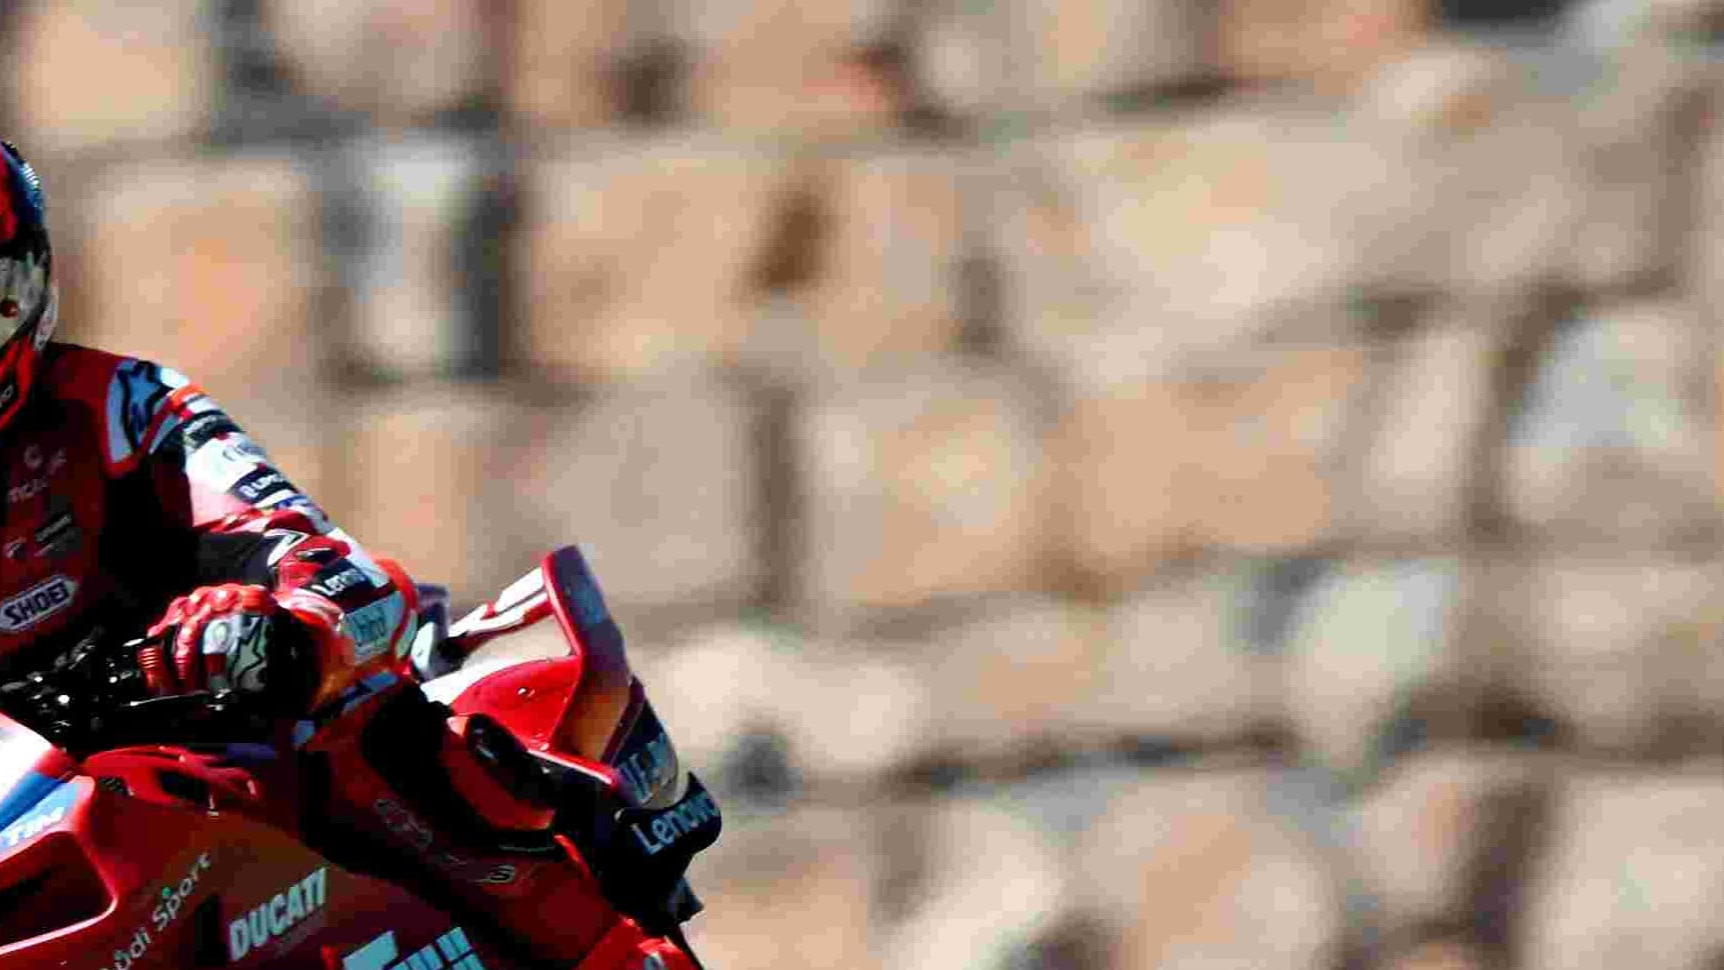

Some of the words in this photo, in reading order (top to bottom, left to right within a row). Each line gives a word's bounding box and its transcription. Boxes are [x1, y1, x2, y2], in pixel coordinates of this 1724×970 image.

[4, 580, 71, 627] SHOEI
[151, 851, 211, 932] Sport
[229, 867, 327, 962] DUCATI
